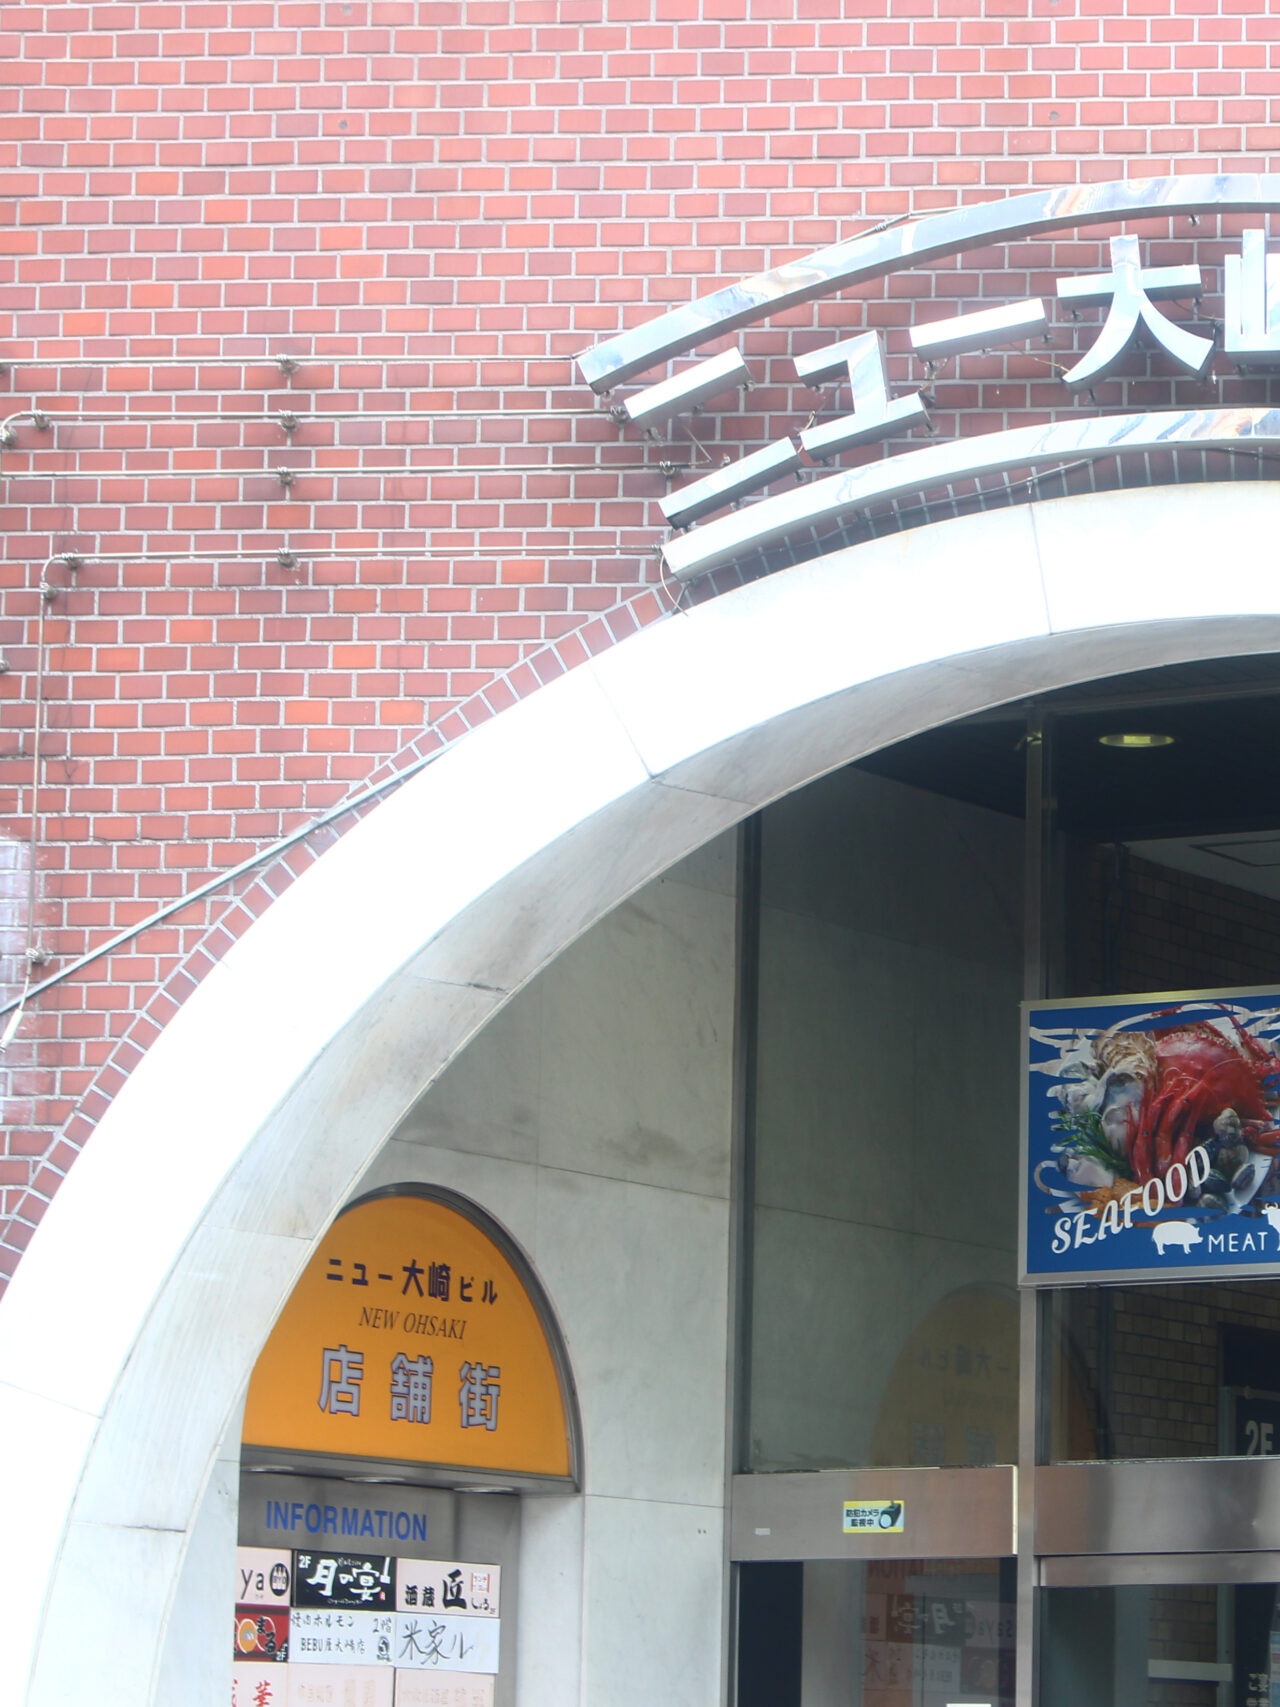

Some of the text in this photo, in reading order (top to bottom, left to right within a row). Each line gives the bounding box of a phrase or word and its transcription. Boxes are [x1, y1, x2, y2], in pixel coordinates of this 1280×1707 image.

[1051, 1145, 1211, 1254] SEAFOOD
[1208, 1231, 1268, 1254] MEAT
[326, 1258, 498, 1305] ニュー大崎ビル
[358, 1306, 468, 1341] NEW OHSAKI
[317, 1344, 501, 1432] 店舗街
[266, 1501, 428, 1541] INFORMATION
[298, 1555, 312, 1569] 2F
